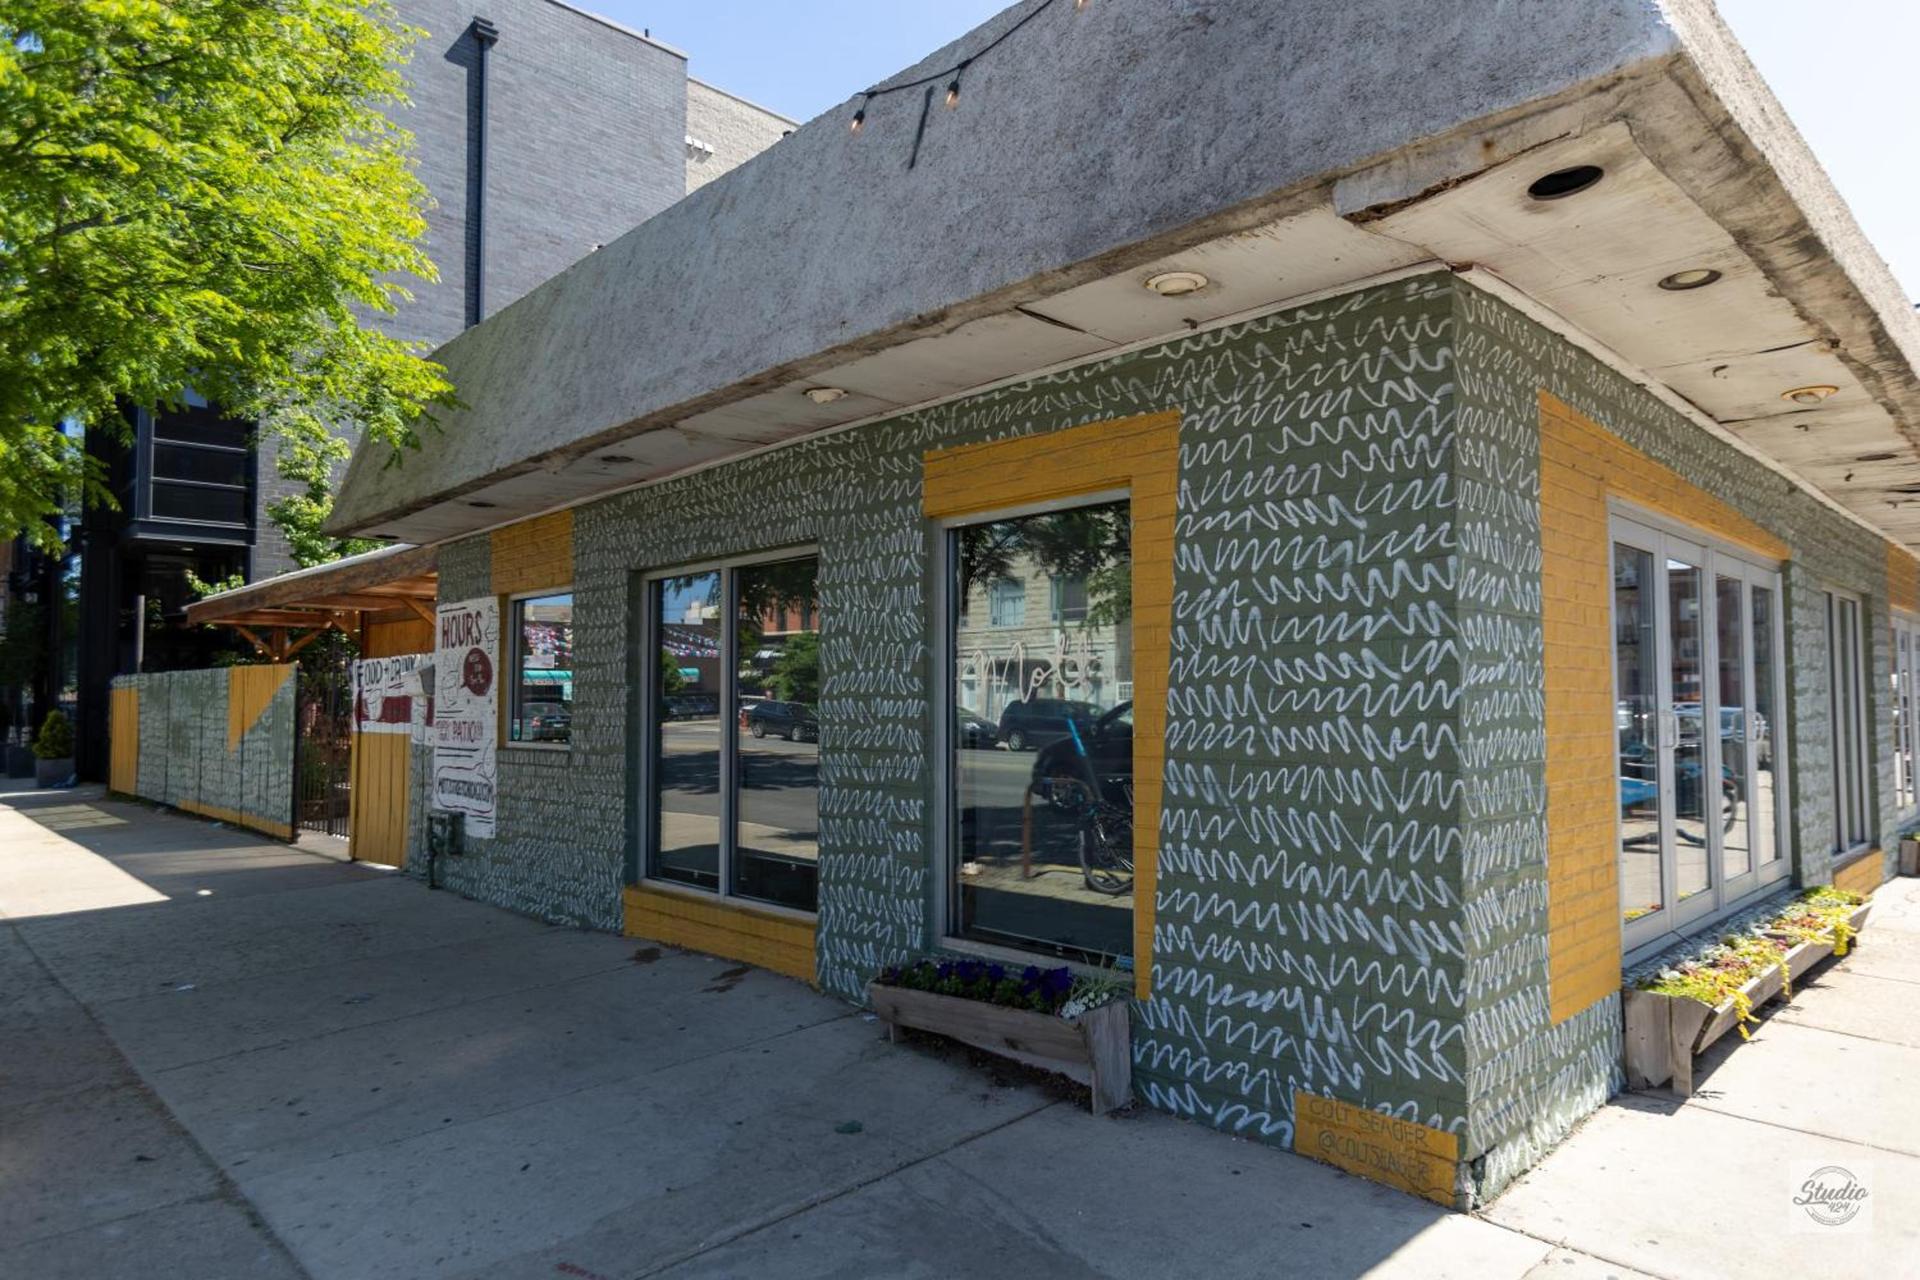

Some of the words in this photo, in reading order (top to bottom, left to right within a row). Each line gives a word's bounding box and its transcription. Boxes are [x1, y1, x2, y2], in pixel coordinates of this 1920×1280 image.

[442, 610, 482, 649] HOURS
[357, 660, 383, 688] FOOD
[1310, 1101, 1351, 1125] COLT
